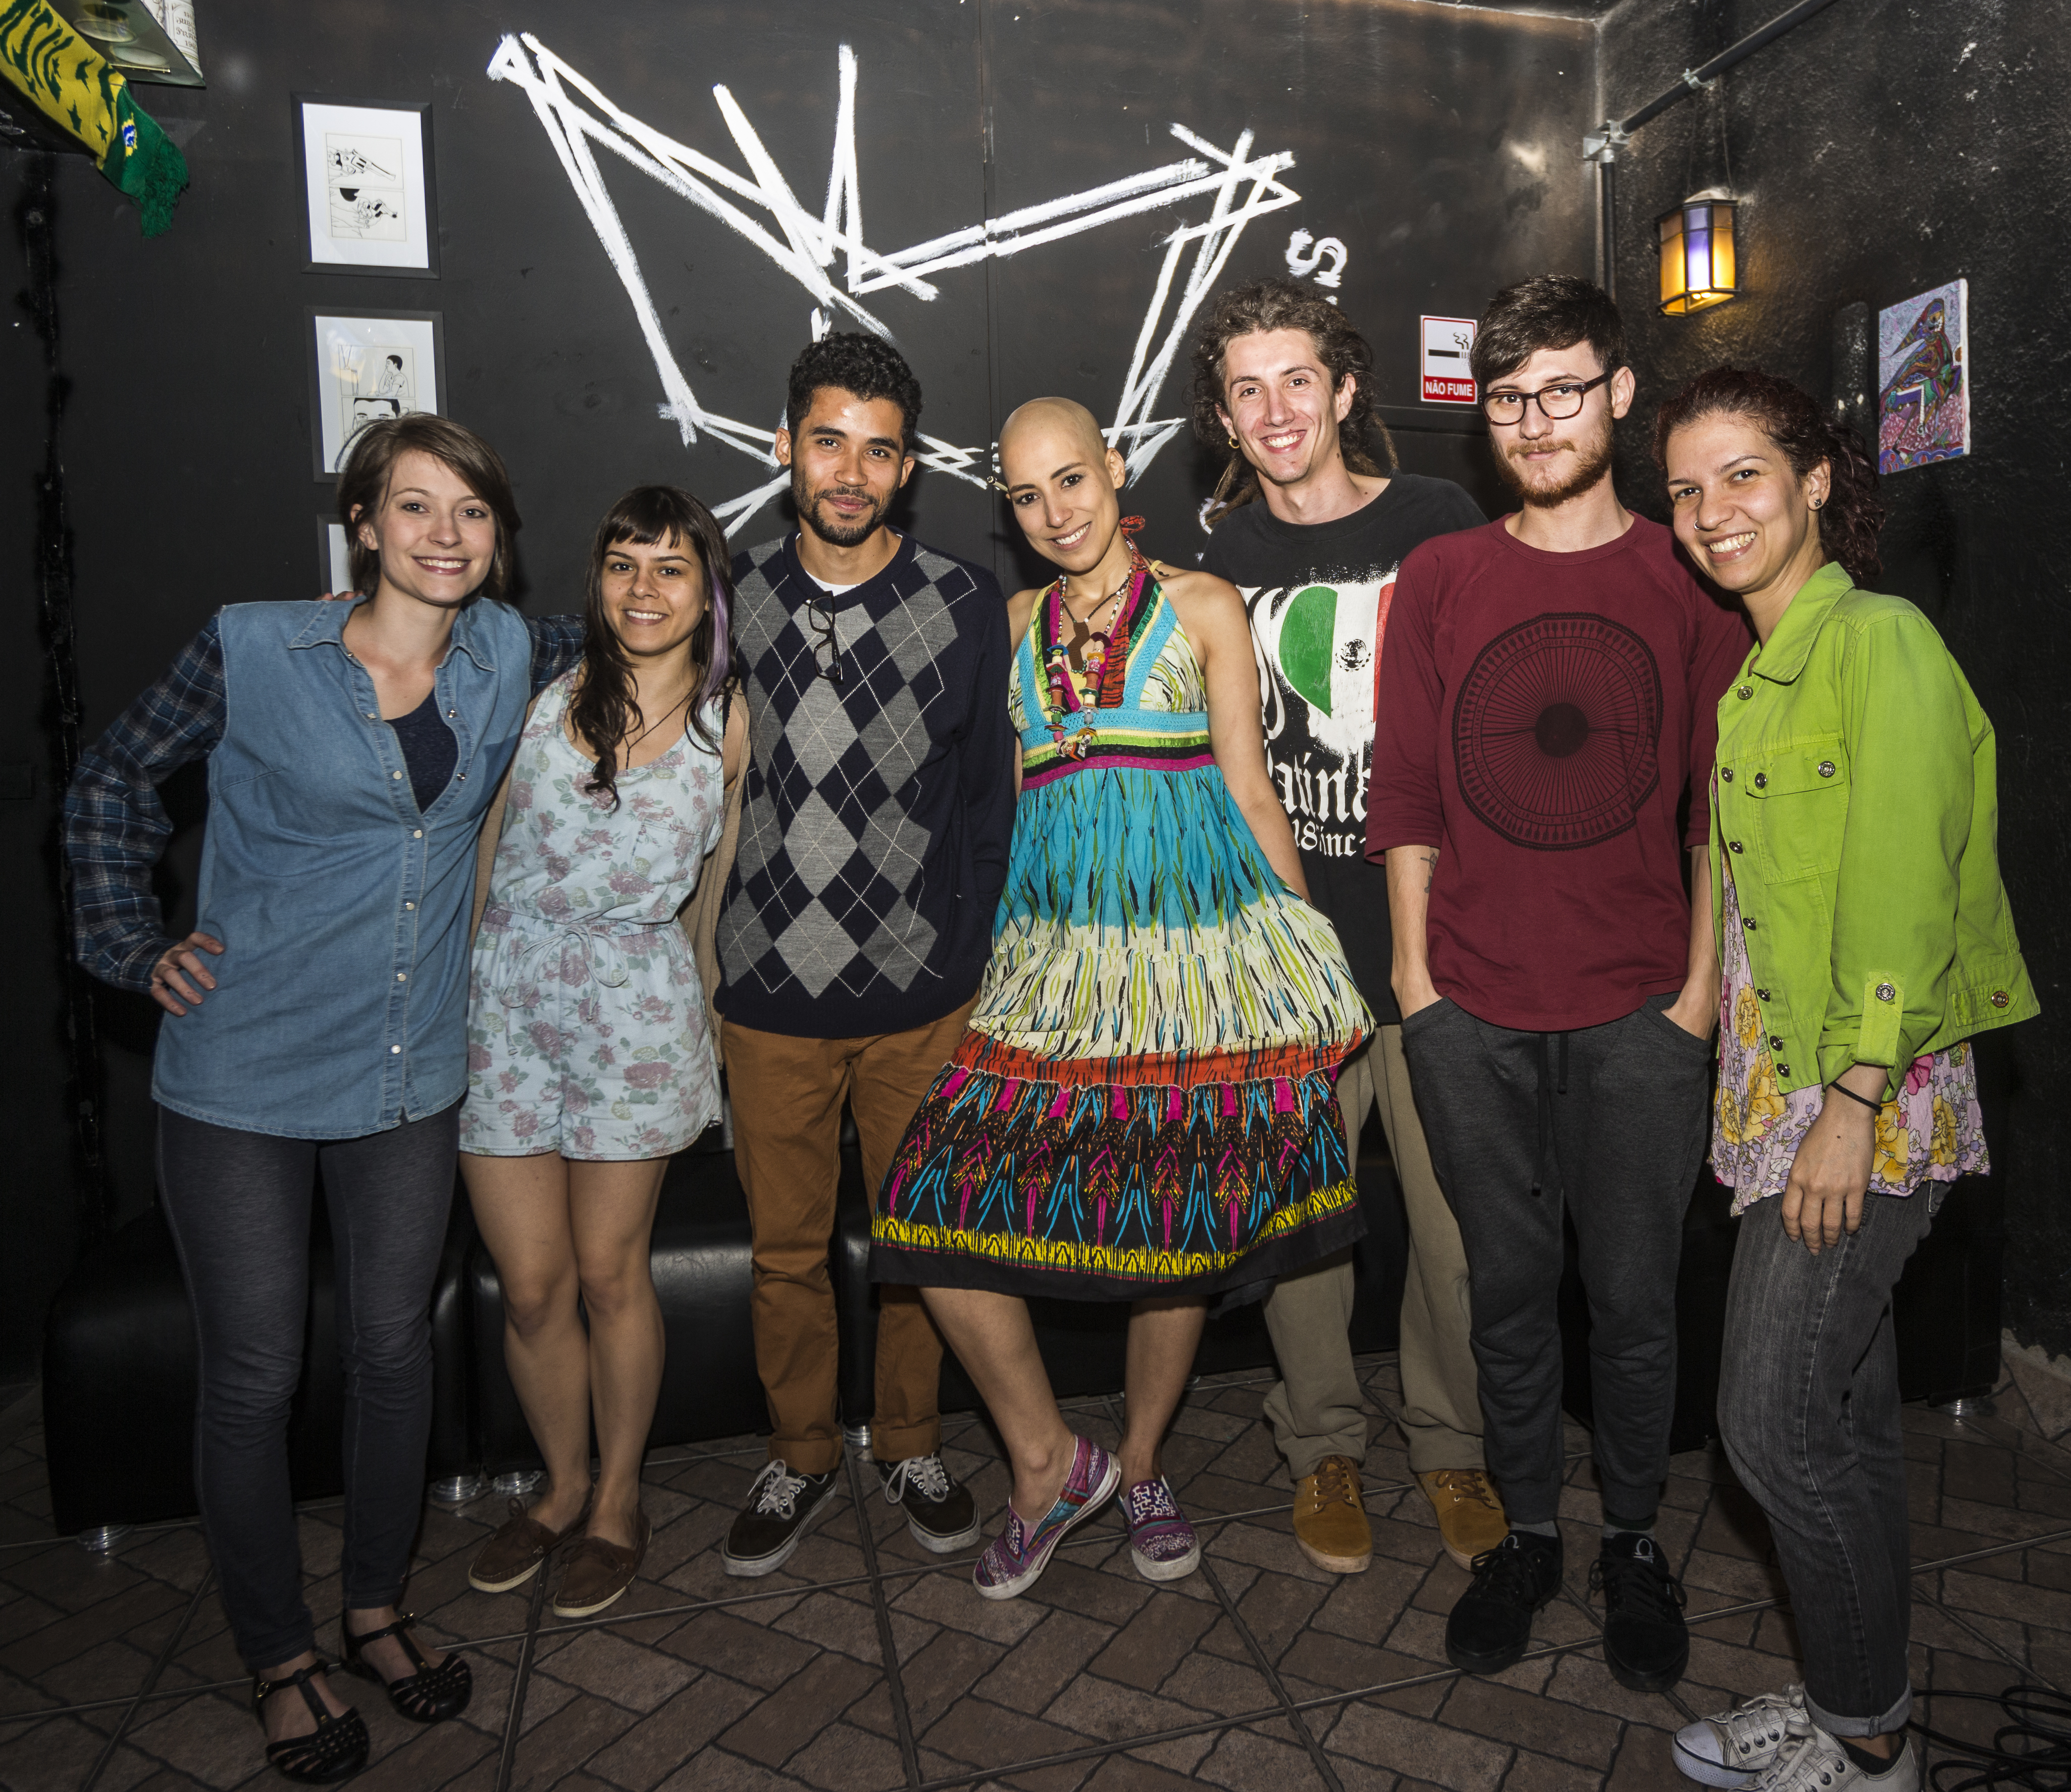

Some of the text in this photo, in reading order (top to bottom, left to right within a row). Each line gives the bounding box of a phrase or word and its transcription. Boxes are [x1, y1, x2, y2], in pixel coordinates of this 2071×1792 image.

[1425, 379, 1473, 396] NÃO FUME
[1534, 638, 1564, 649] PASSION
[1569, 639, 1621, 660] PERSEVERANCE
[1492, 646, 1531, 681] EQUILIBRIUM
[1621, 661, 1641, 693] FIRMNESS
[1474, 704, 1483, 751] PAINSTAKING
[1476, 756, 1487, 777] TRUST
[1487, 780, 1516, 810] KNOWLEDGE
[1587, 797, 1621, 816] STRENGTH
[1560, 814, 1581, 824] WORK
